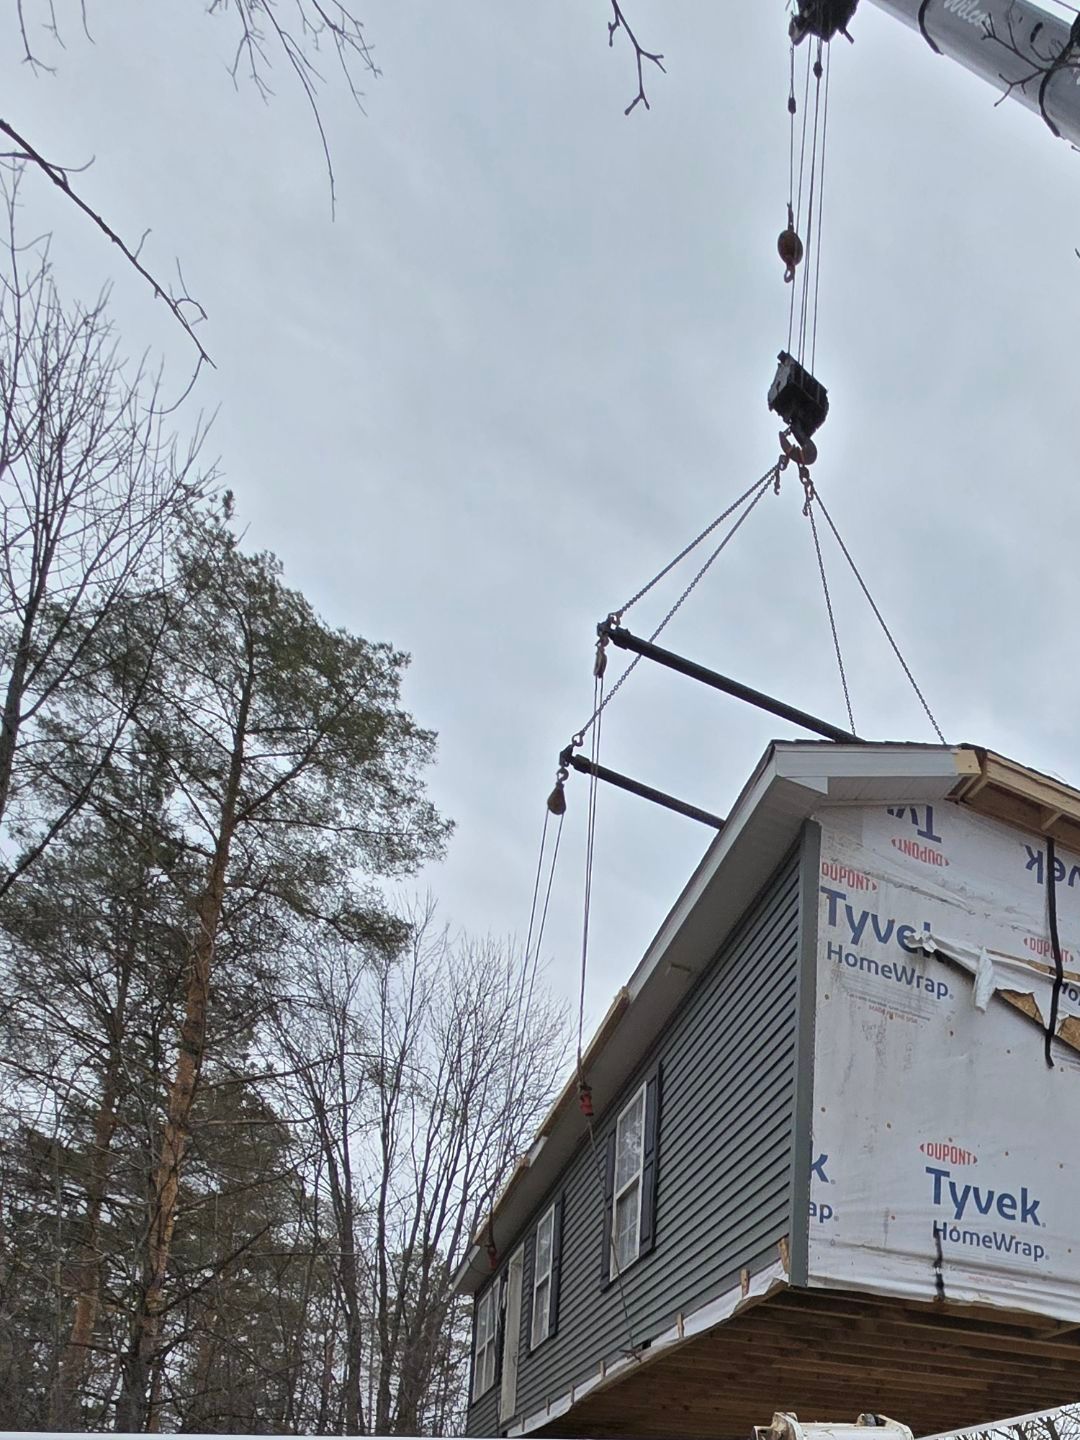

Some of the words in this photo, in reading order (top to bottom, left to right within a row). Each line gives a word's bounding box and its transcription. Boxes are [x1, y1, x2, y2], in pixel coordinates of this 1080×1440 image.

[897, 838, 943, 867] DUPONT
[821, 862, 870, 891] DUPONT
[827, 941, 949, 1000] HomeWrap
[927, 1143, 972, 1165] DUPONT
[925, 1167, 1040, 1226] Tyvek
[933, 1220, 1044, 1262] HomeWrap
